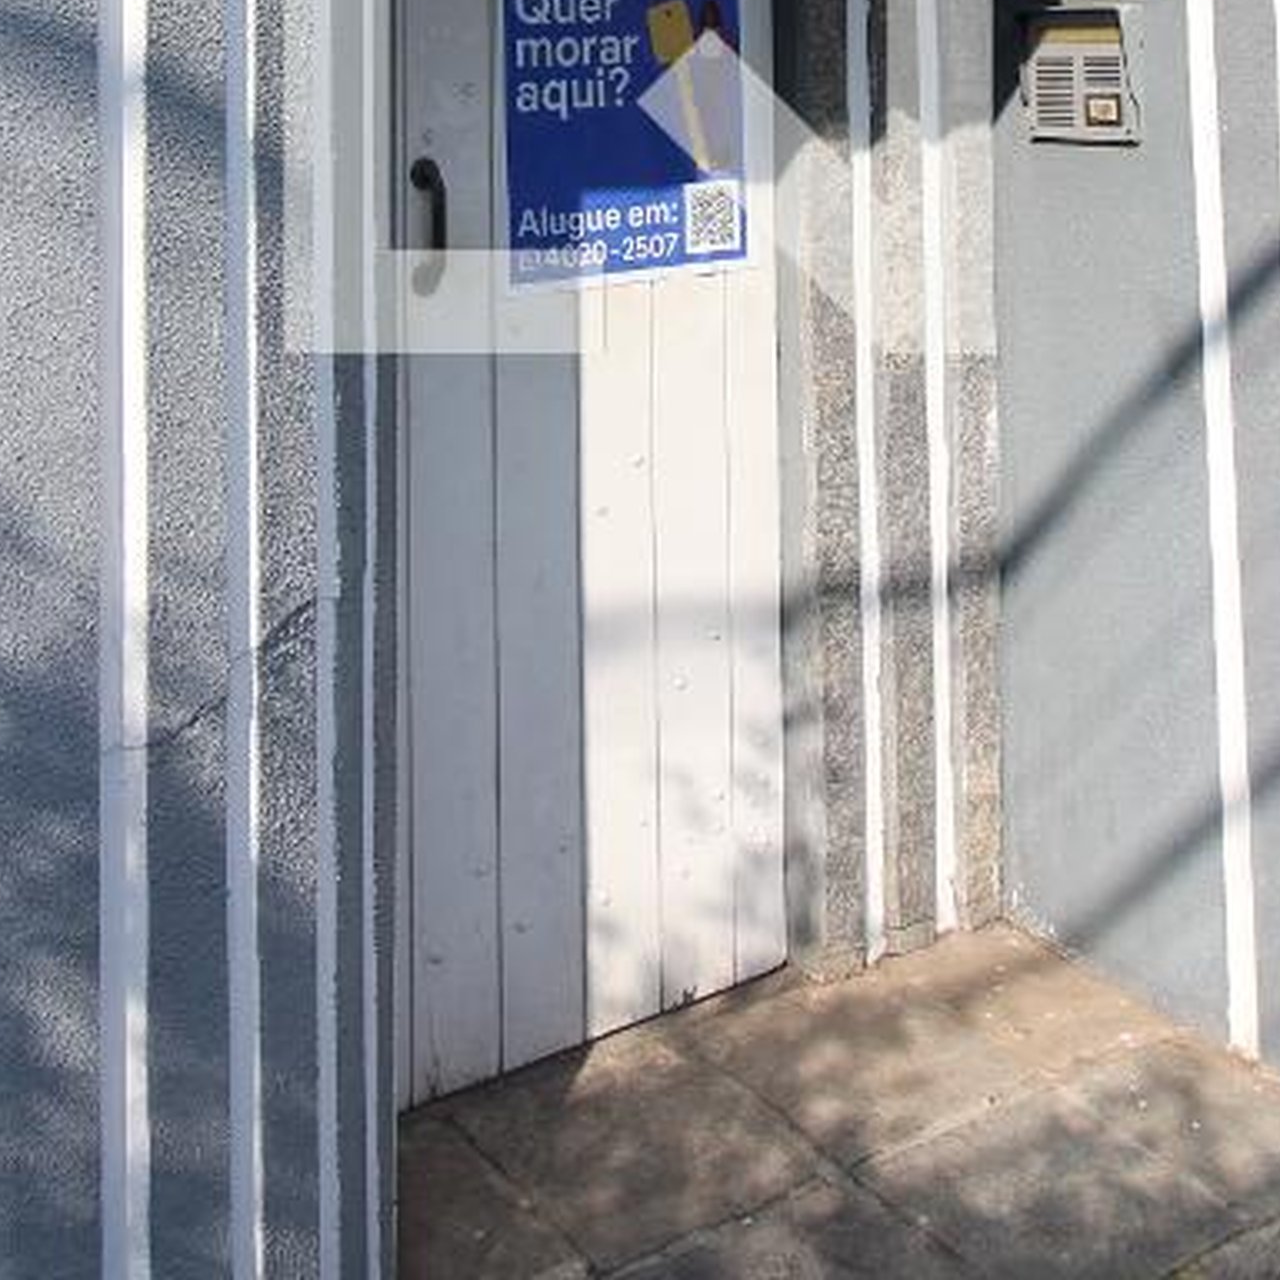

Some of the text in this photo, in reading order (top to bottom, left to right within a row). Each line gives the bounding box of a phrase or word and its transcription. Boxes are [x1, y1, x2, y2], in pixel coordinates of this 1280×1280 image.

[516, 34, 638, 68] morar
[516, 67, 630, 120] aqui?
[518, 201, 679, 240] Alugue em:
